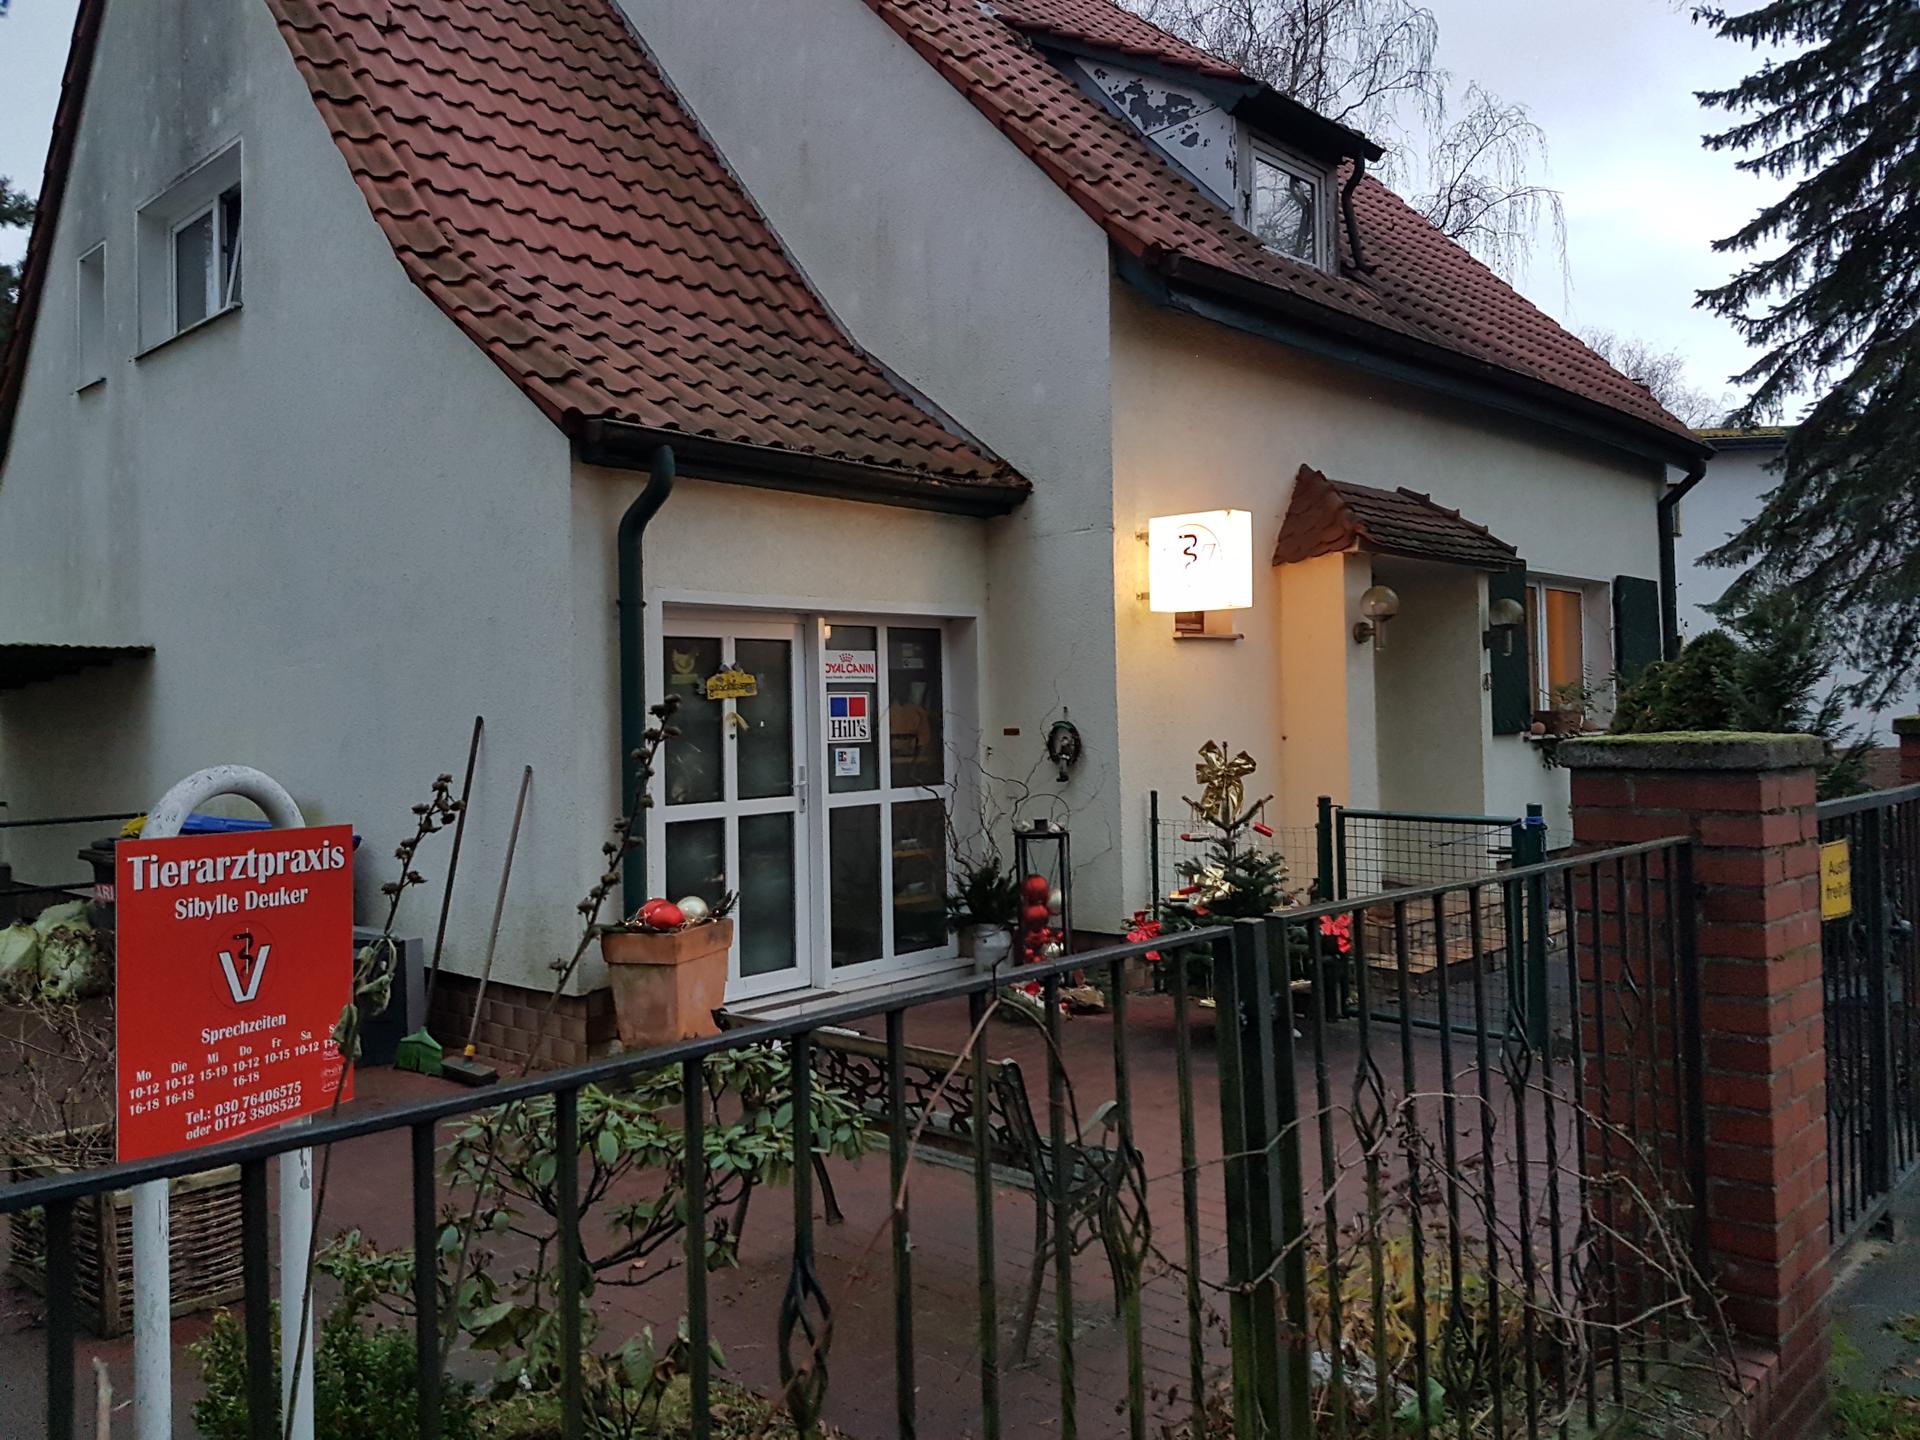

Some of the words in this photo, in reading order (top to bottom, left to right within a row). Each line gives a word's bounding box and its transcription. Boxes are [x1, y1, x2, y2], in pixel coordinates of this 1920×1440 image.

[825, 663, 846, 673] OYAL
[846, 663, 874, 673] CANIN
[831, 719, 867, 738] Hill's
[127, 840, 345, 890] Tierarztpraxis
[175, 893, 239, 920] Sibylle
[245, 887, 309, 910] Deuker
[201, 1014, 287, 1044] Sprechzeiten
[129, 1083, 160, 1099] 10-12
[165, 1074, 195, 1091] 10-12
[200, 1065, 228, 1081] 15-19
[232, 1057, 260, 1073] 10-12
[264, 1049, 290, 1064] 10-15
[294, 1041, 320, 1057] 10-12
[136, 1070, 152, 1082] Mo
[171, 1061, 188, 1074] Die
[207, 1052, 219, 1064] Mi
[239, 1045, 252, 1057] Do
[271, 1037, 282, 1048] Fr
[300, 1030, 312, 1041] Sa
[129, 1098, 160, 1116] 16-18
[165, 1089, 195, 1106] 16-18
[232, 1072, 260, 1087] 16-18
[185, 1108, 211, 1125] Tel.:
[214, 1099, 239, 1116] 030
[242, 1081, 302, 1109] 76406575
[186, 1125, 212, 1140] oder
[214, 1112, 246, 1131] 0172
[249, 1095, 302, 1120] 3808522
